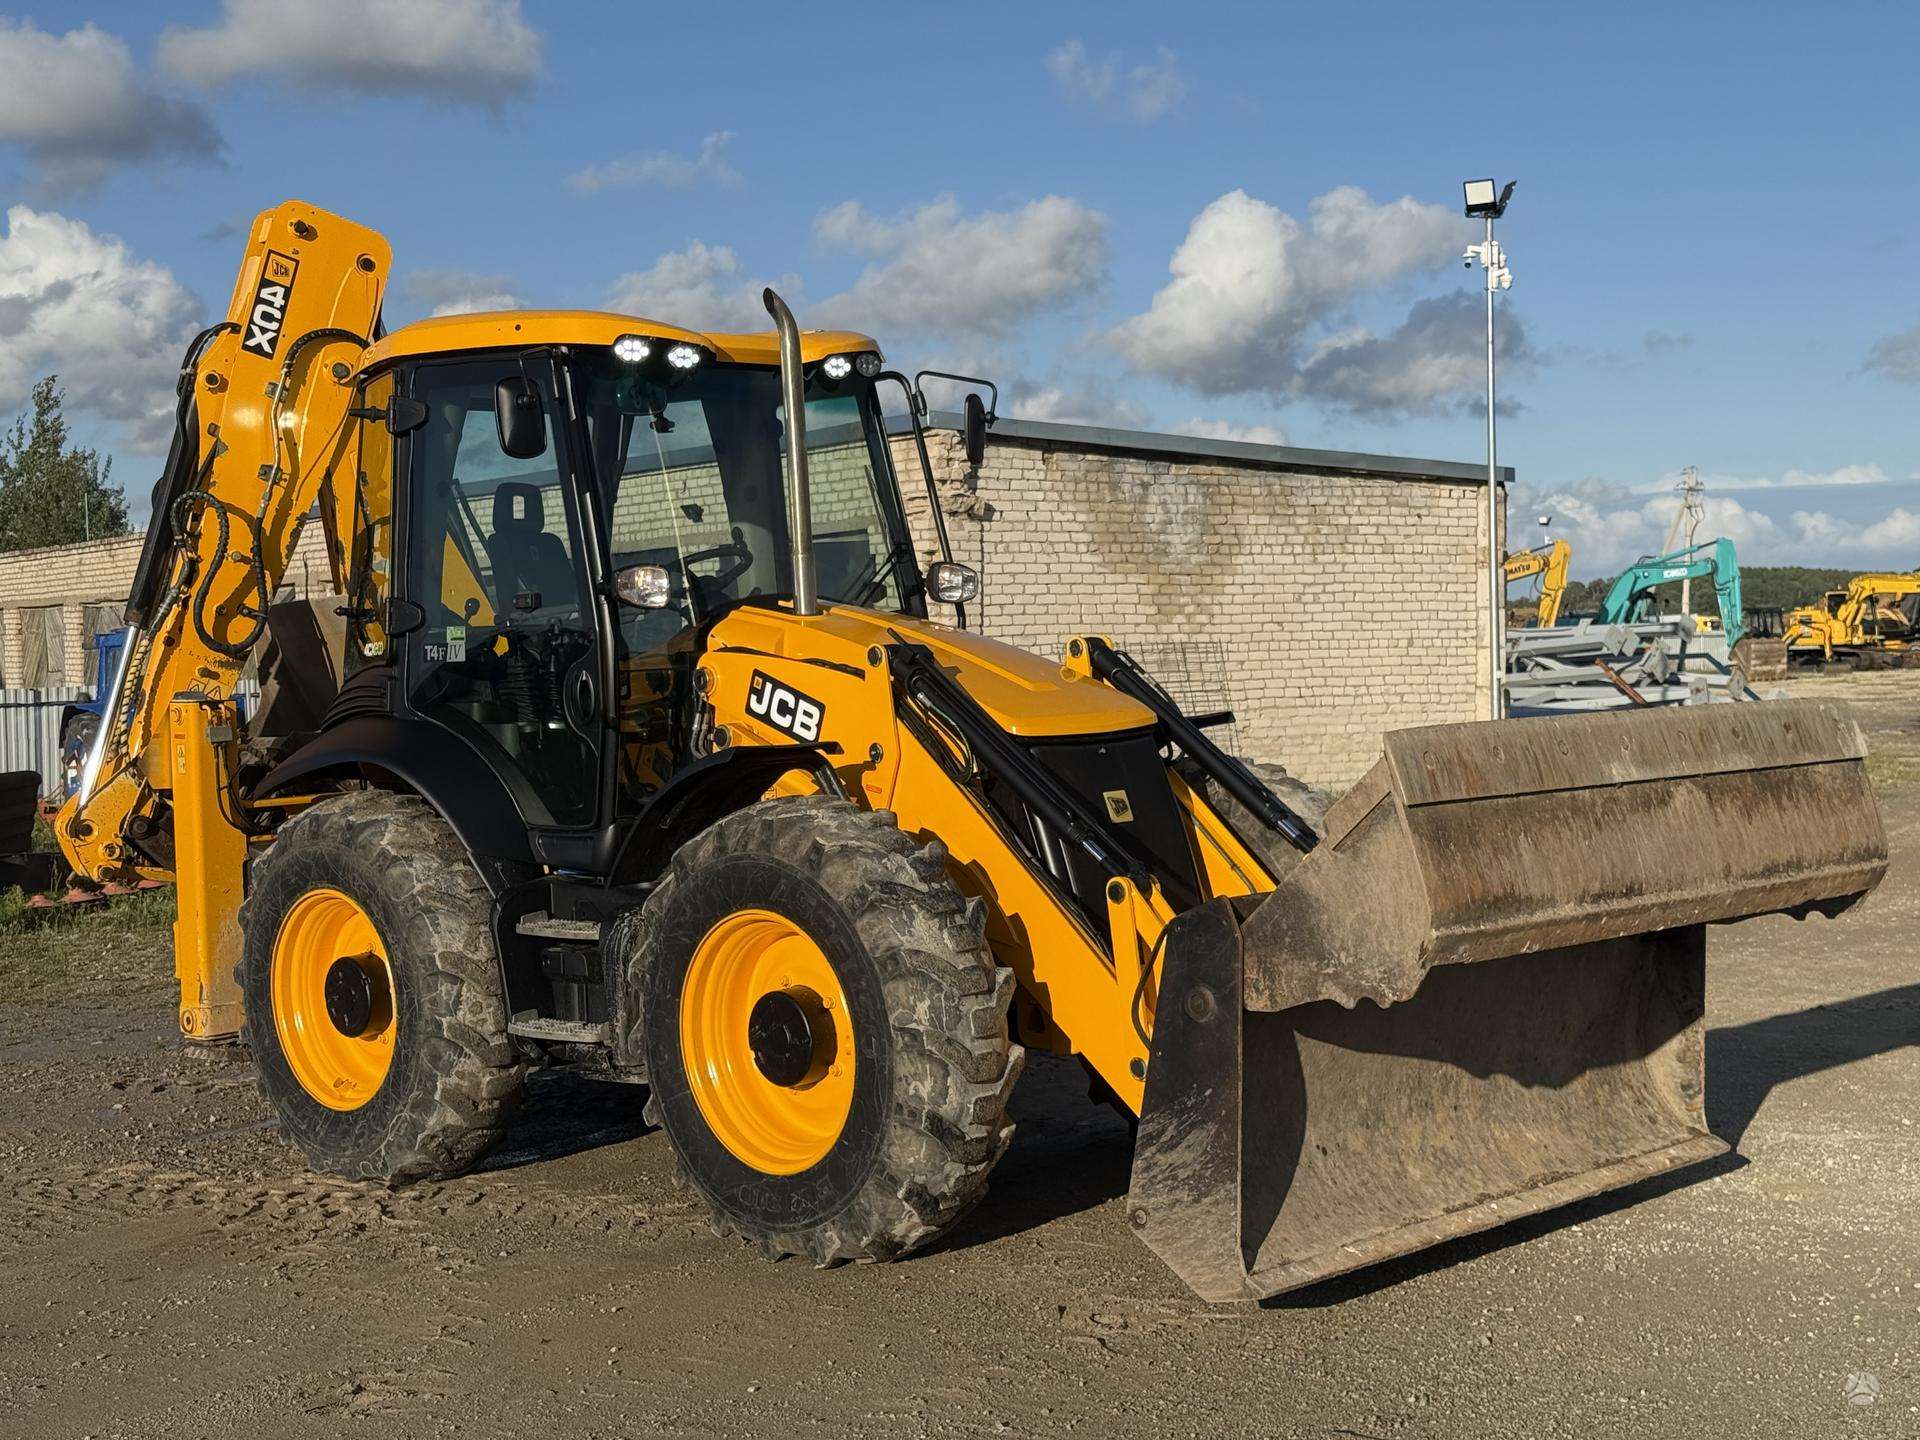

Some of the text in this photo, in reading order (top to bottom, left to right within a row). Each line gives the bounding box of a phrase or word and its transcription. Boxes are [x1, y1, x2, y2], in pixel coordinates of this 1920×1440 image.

[244, 285, 286, 354] 4CX
[1508, 563, 1531, 575] MATSU
[749, 681, 820, 742] JCB
